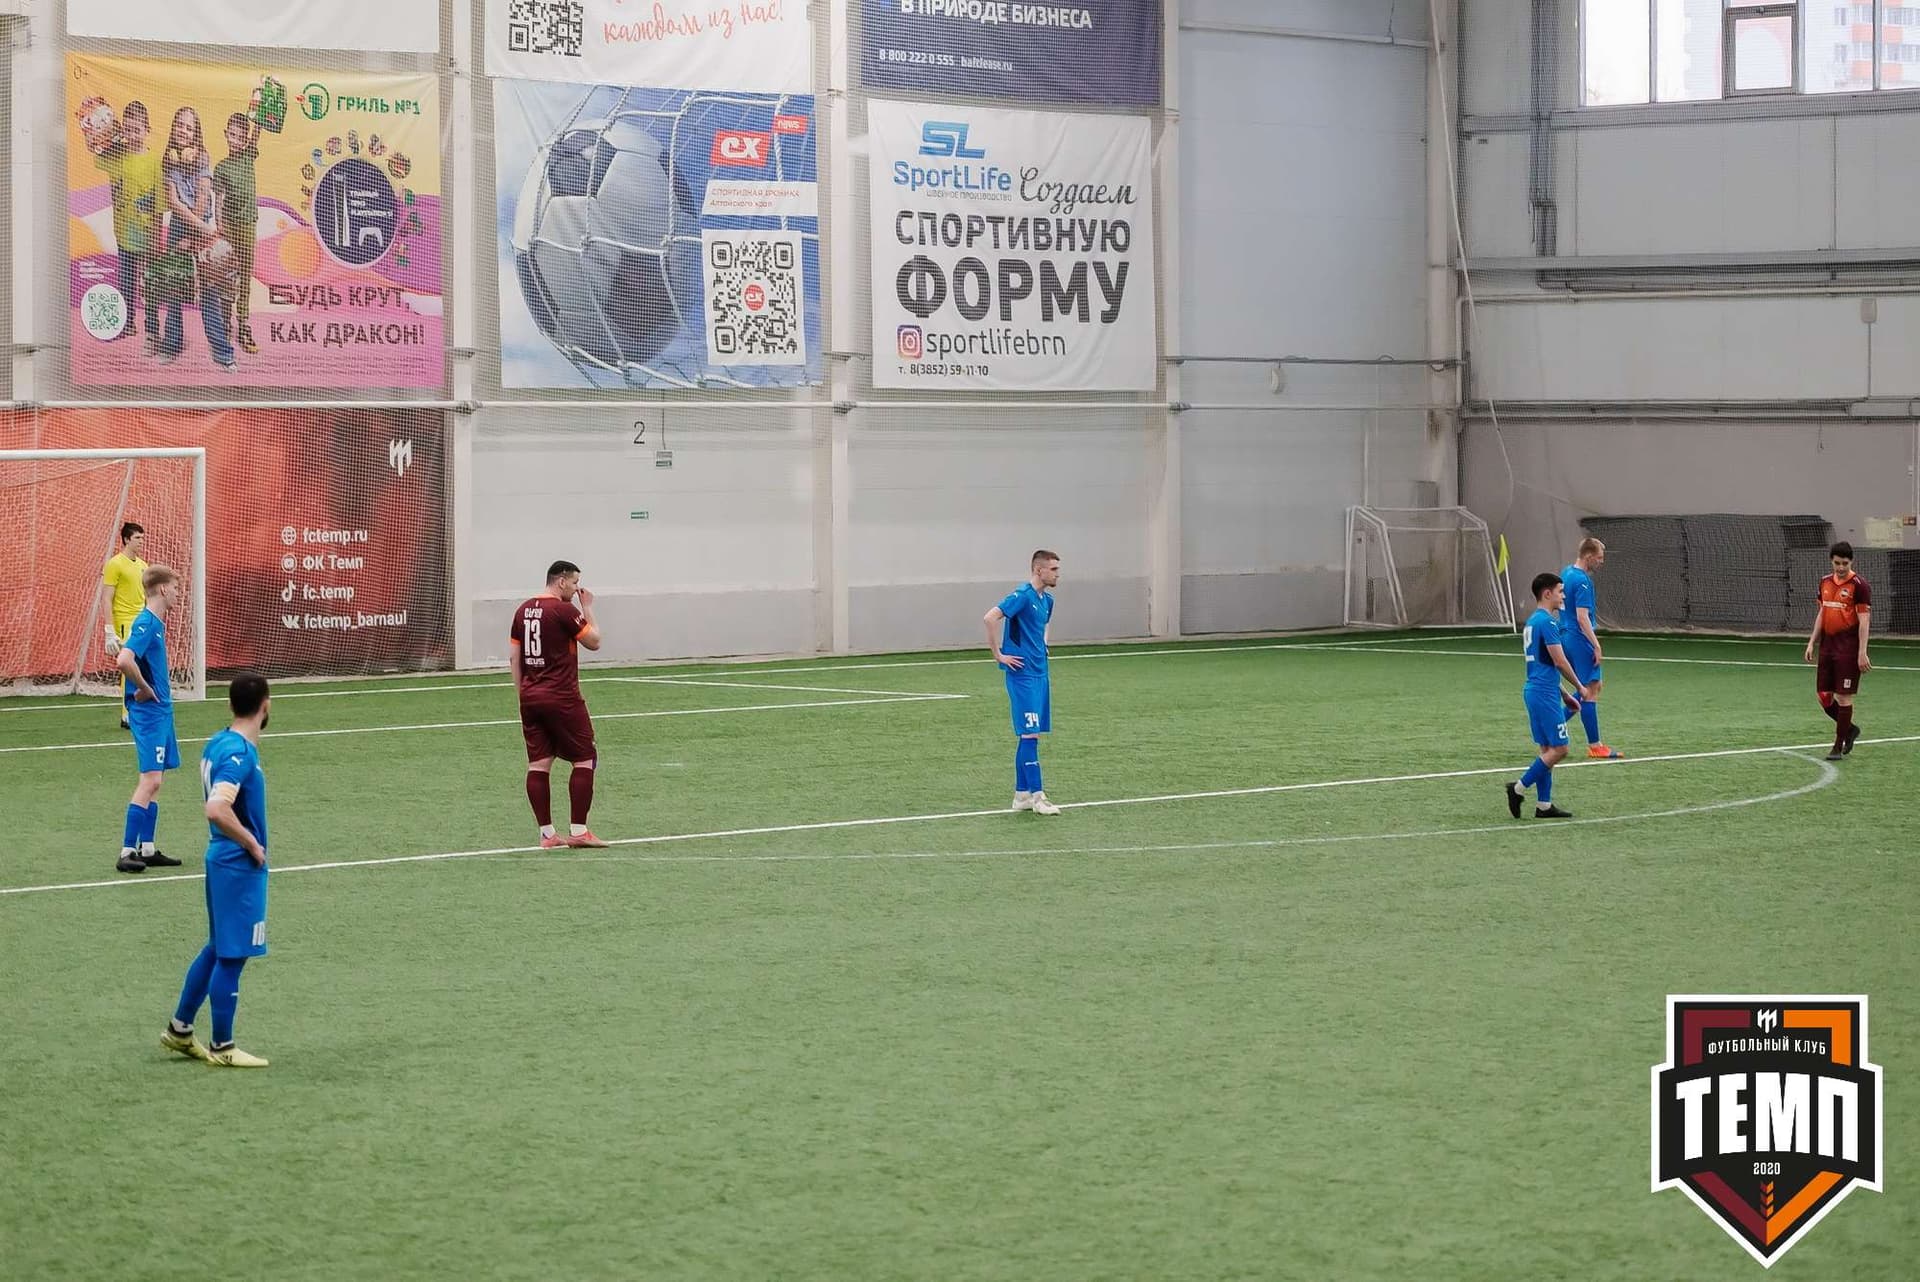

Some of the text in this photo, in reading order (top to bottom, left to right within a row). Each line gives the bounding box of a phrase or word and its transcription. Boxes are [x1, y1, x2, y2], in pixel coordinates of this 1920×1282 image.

[708, 9, 735, 39] из
[918, 0, 1007, 25] ПРИРОДЕ
[1012, 4, 1092, 29] БИЗНЕСА
[888, 50, 906, 62] 800
[909, 52, 927, 63] 222
[937, 55, 954, 66] 555
[337, 95, 389, 114] ГРИЛЬ
[919, 120, 986, 159] SL
[893, 161, 1012, 191] SportLife
[1020, 165, 1138, 214] Создаем
[895, 210, 1131, 253] СПОРТИВНУЮ
[269, 283, 410, 311] БУДЬ КРУТ,
[896, 255, 1130, 323] ФОРМУ
[270, 321, 424, 348] КАК ДРАКОН!
[926, 328, 1066, 360] sportlifebrn
[910, 363, 948, 377] 8(3852)
[633, 421, 646, 444] 2
[303, 527, 368, 545] fctemp.ru
[303, 554, 364, 571] ФК Темп
[303, 583, 354, 601] fc.temp
[304, 610, 407, 630] fctemp_barnaul
[523, 619, 542, 657] 13
[1024, 712, 1040, 728] 34
